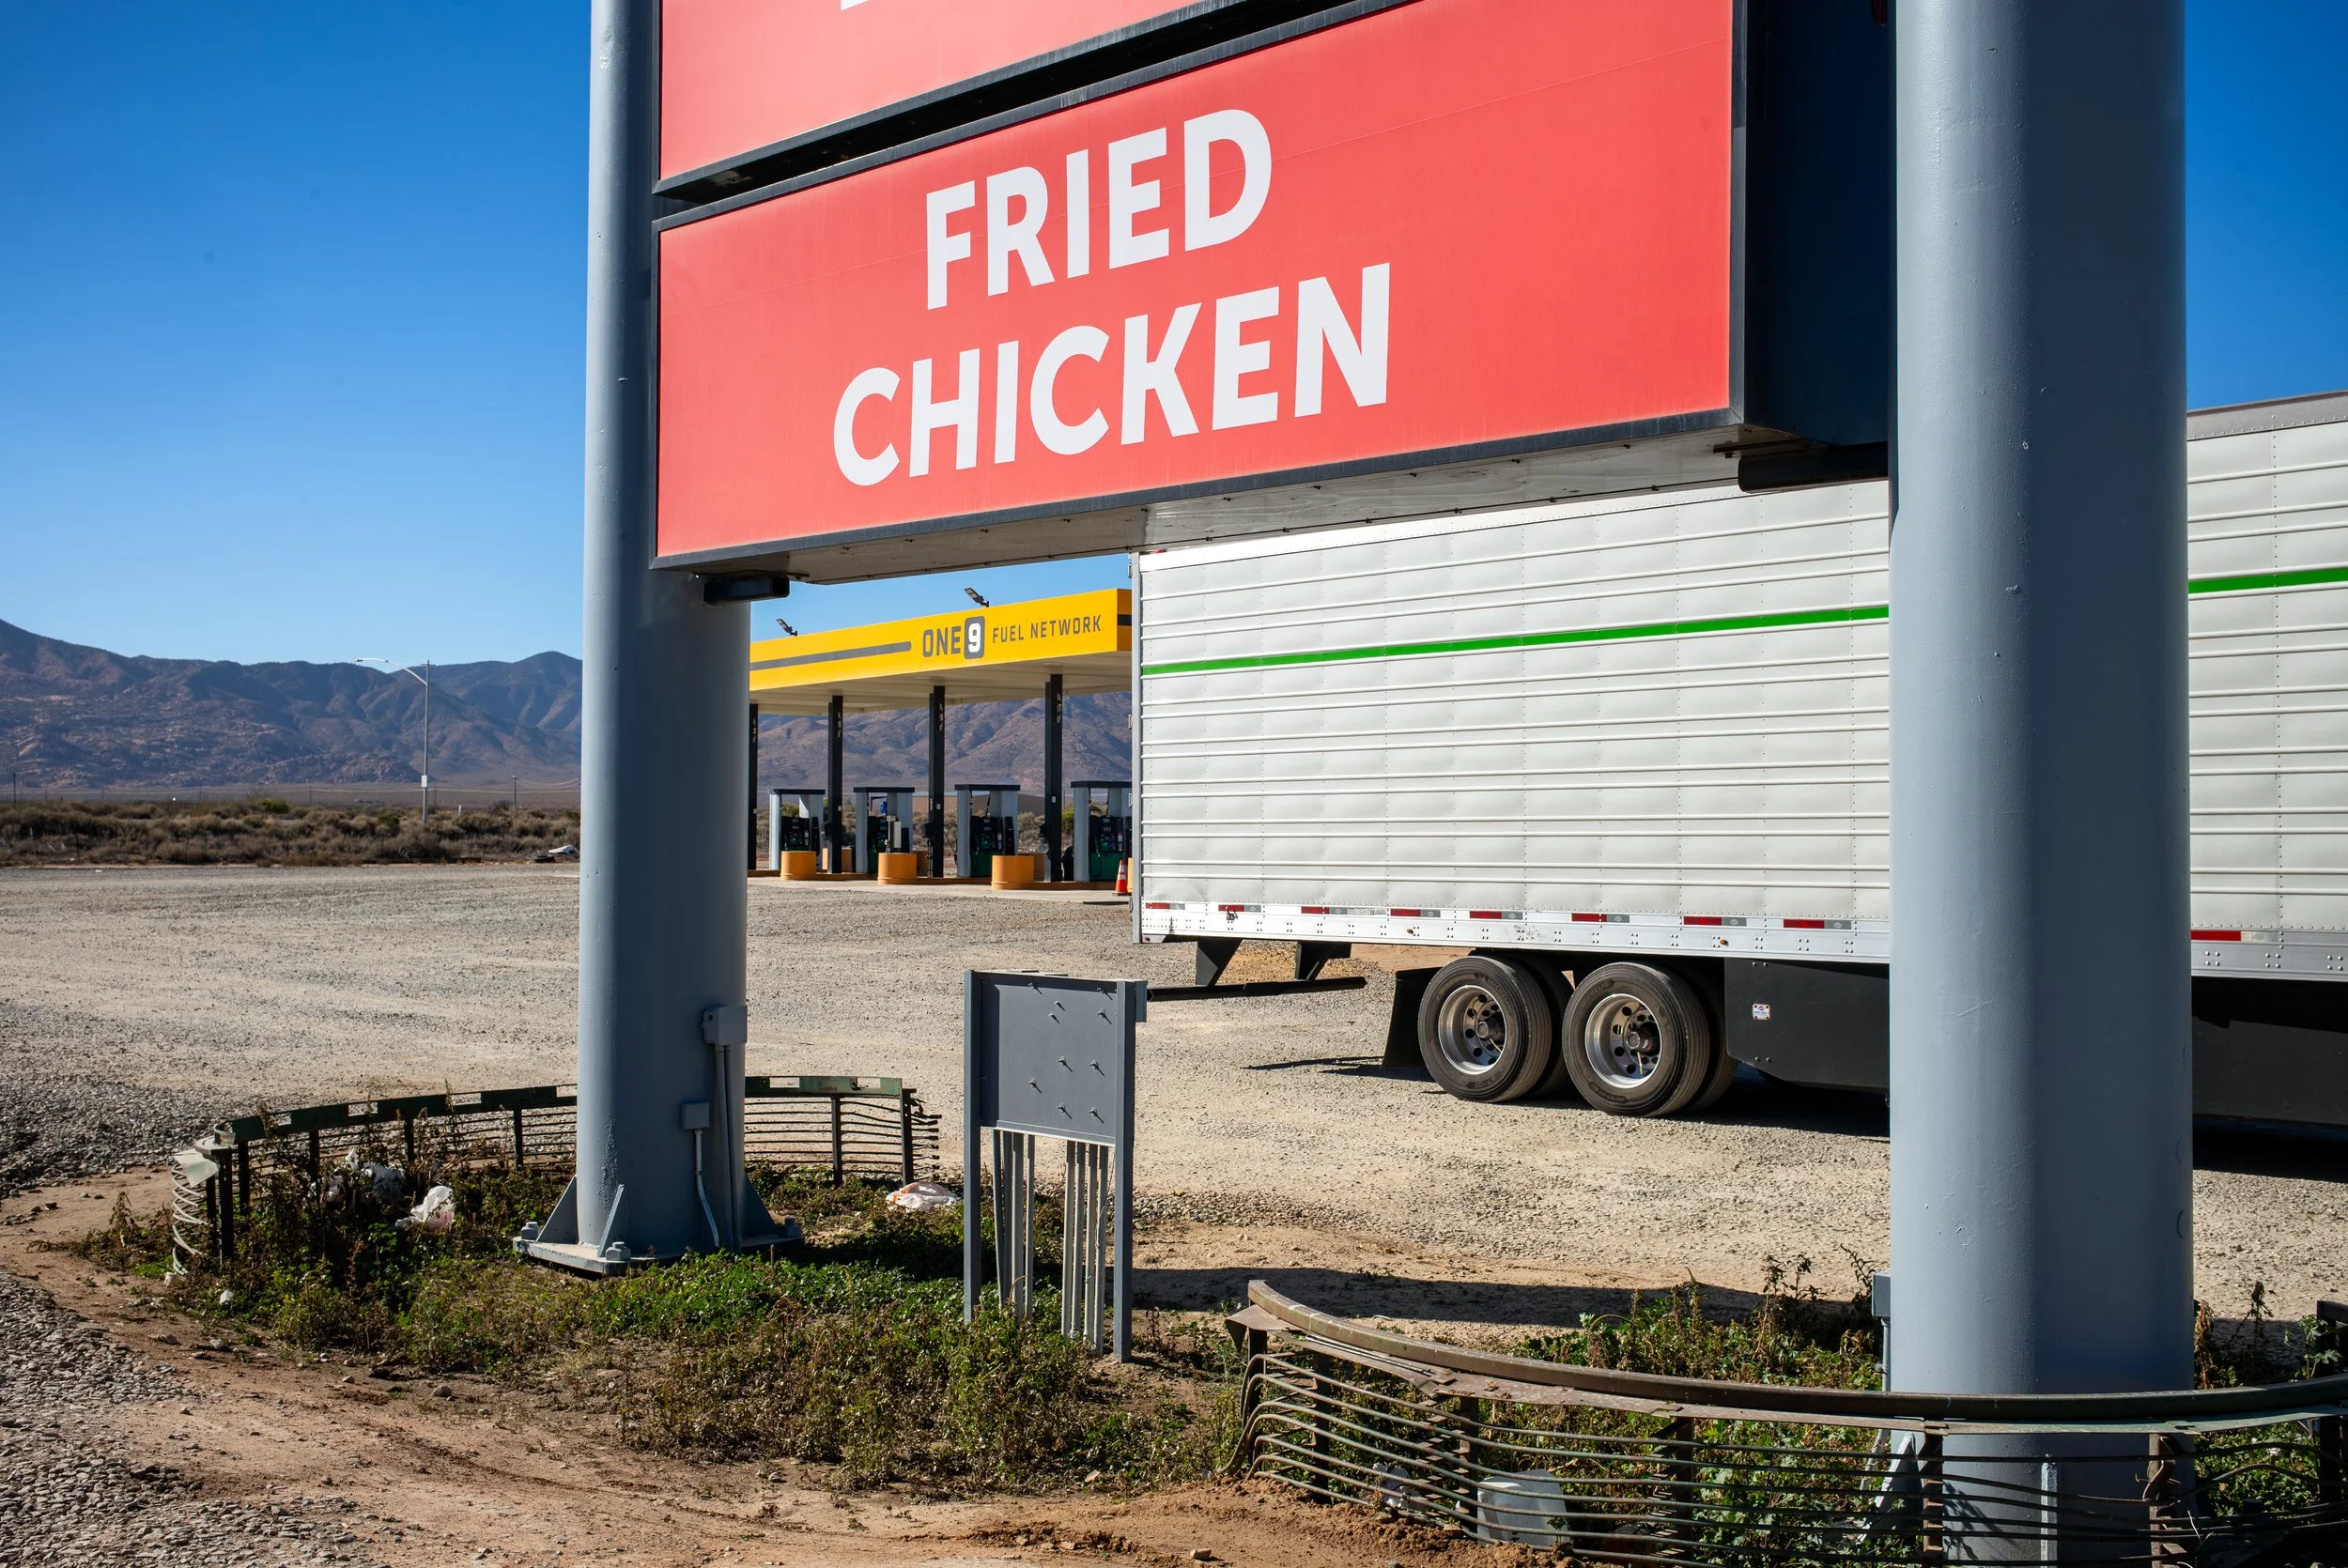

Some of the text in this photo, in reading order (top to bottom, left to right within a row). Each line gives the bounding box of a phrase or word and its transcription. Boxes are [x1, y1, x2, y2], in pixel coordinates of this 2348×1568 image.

[925, 109, 1273, 311] FRIED
[832, 263, 1391, 486] CHICKEN
[993, 624, 1025, 643] FUEL
[1030, 615, 1102, 638] NETWORK
